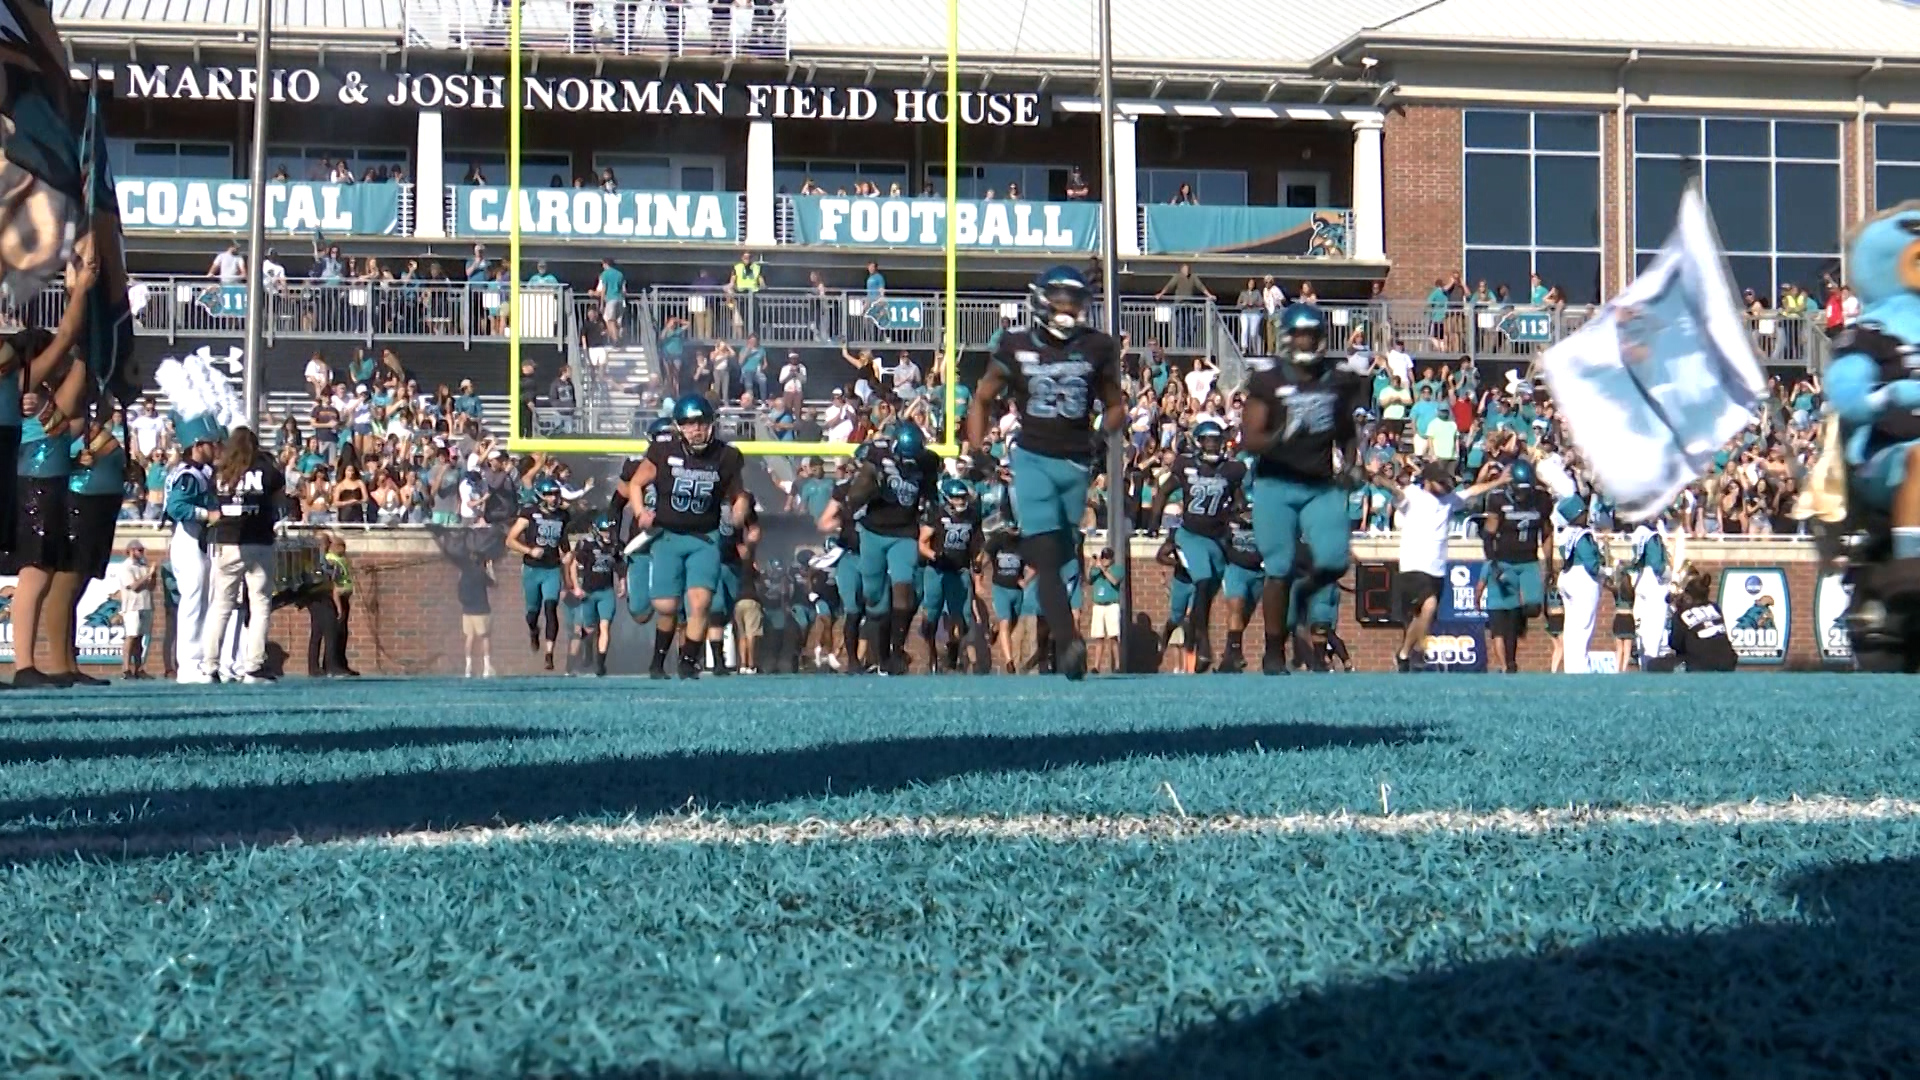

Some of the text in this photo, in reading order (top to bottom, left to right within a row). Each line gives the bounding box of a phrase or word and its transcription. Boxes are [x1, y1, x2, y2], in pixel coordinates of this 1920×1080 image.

[126, 64, 1040, 126] MARRIO & JOSH NORMAN FIELD HOUSE
[116, 180, 353, 230] COASTAL
[469, 188, 727, 238] CAROLINA
[819, 198, 1073, 246] FOOTBALL
[223, 293, 248, 309] 11
[890, 306, 920, 322] 114
[1520, 319, 1548, 335] 113
[671, 477, 714, 515] 55
[1187, 485, 1224, 516] 27
[1363, 567, 1390, 614] 2
[79, 626, 126, 644] 202
[1730, 629, 1778, 648] 2010
